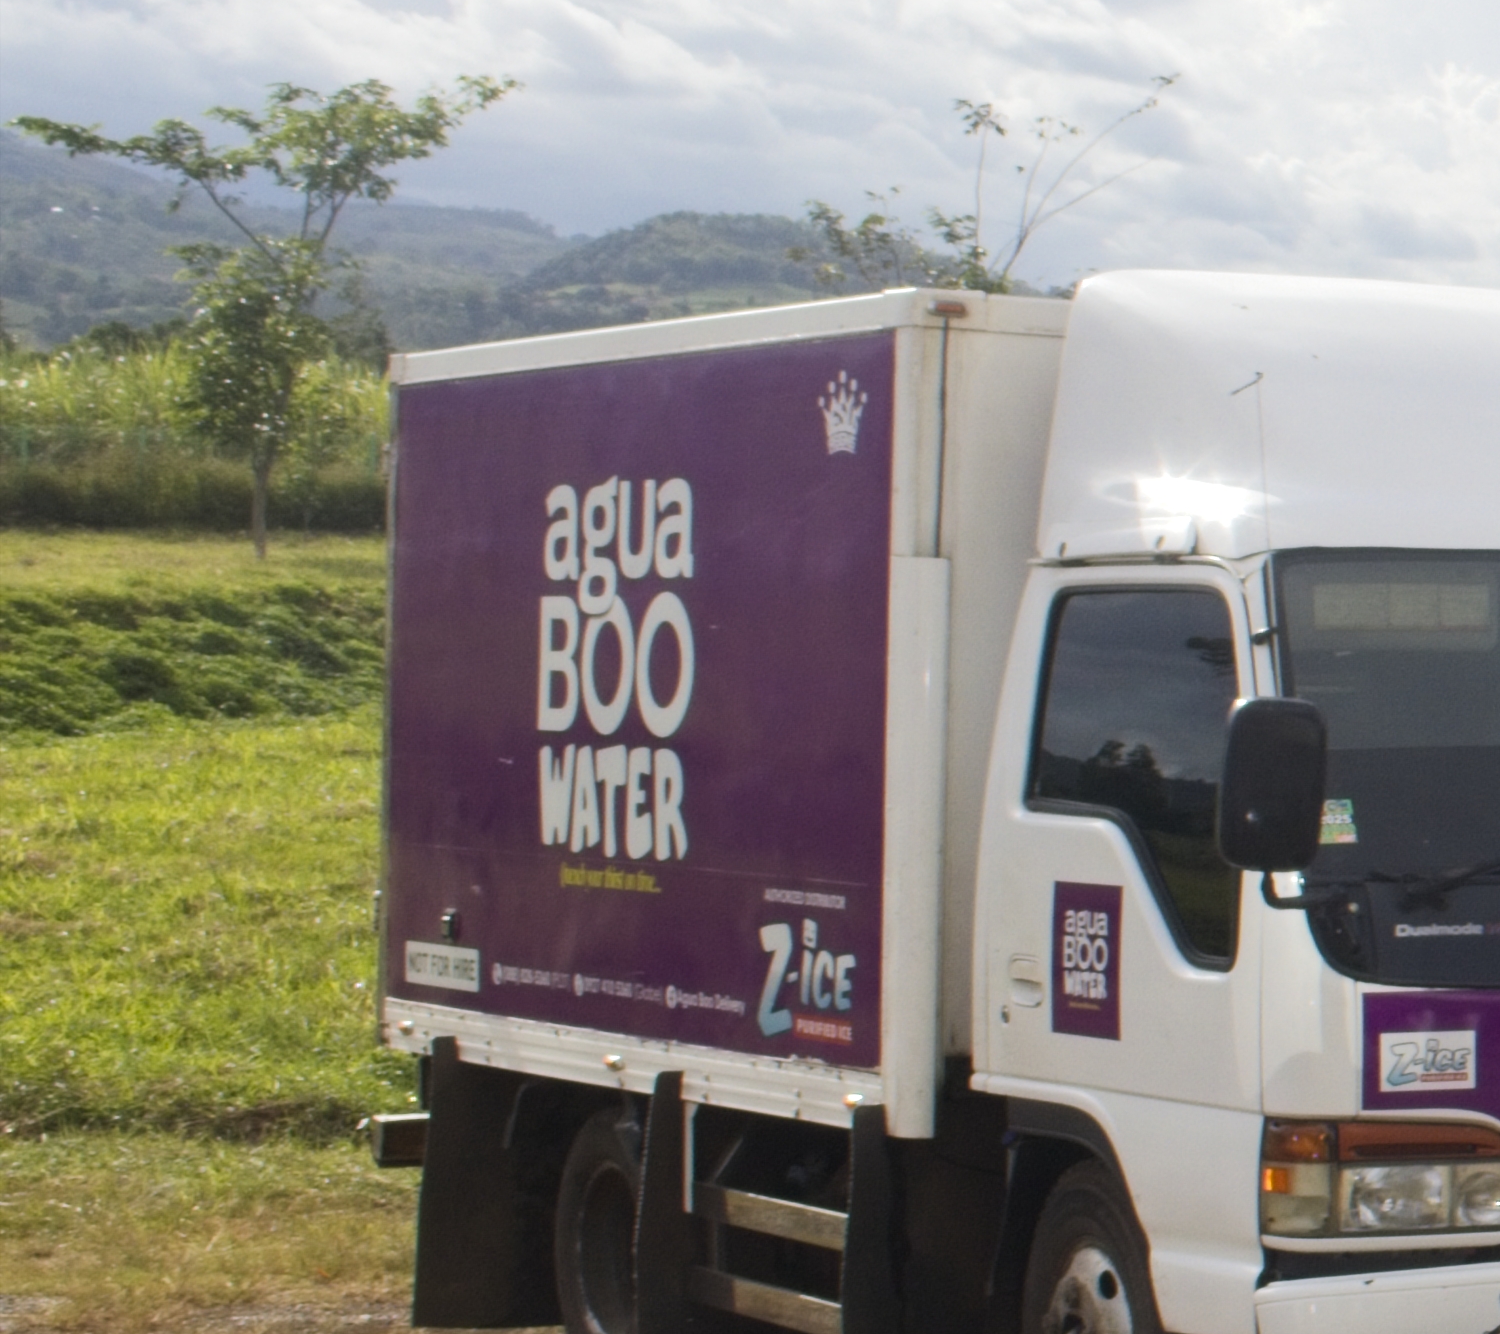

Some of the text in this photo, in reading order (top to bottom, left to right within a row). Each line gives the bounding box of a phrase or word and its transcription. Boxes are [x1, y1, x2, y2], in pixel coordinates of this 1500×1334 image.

[544, 475, 694, 616] agua
[537, 591, 695, 739] BOO
[538, 743, 689, 862] WATER
[1063, 935, 1109, 972] BOO
[1064, 909, 1109, 942] agua
[1064, 969, 1108, 1000] WATER
